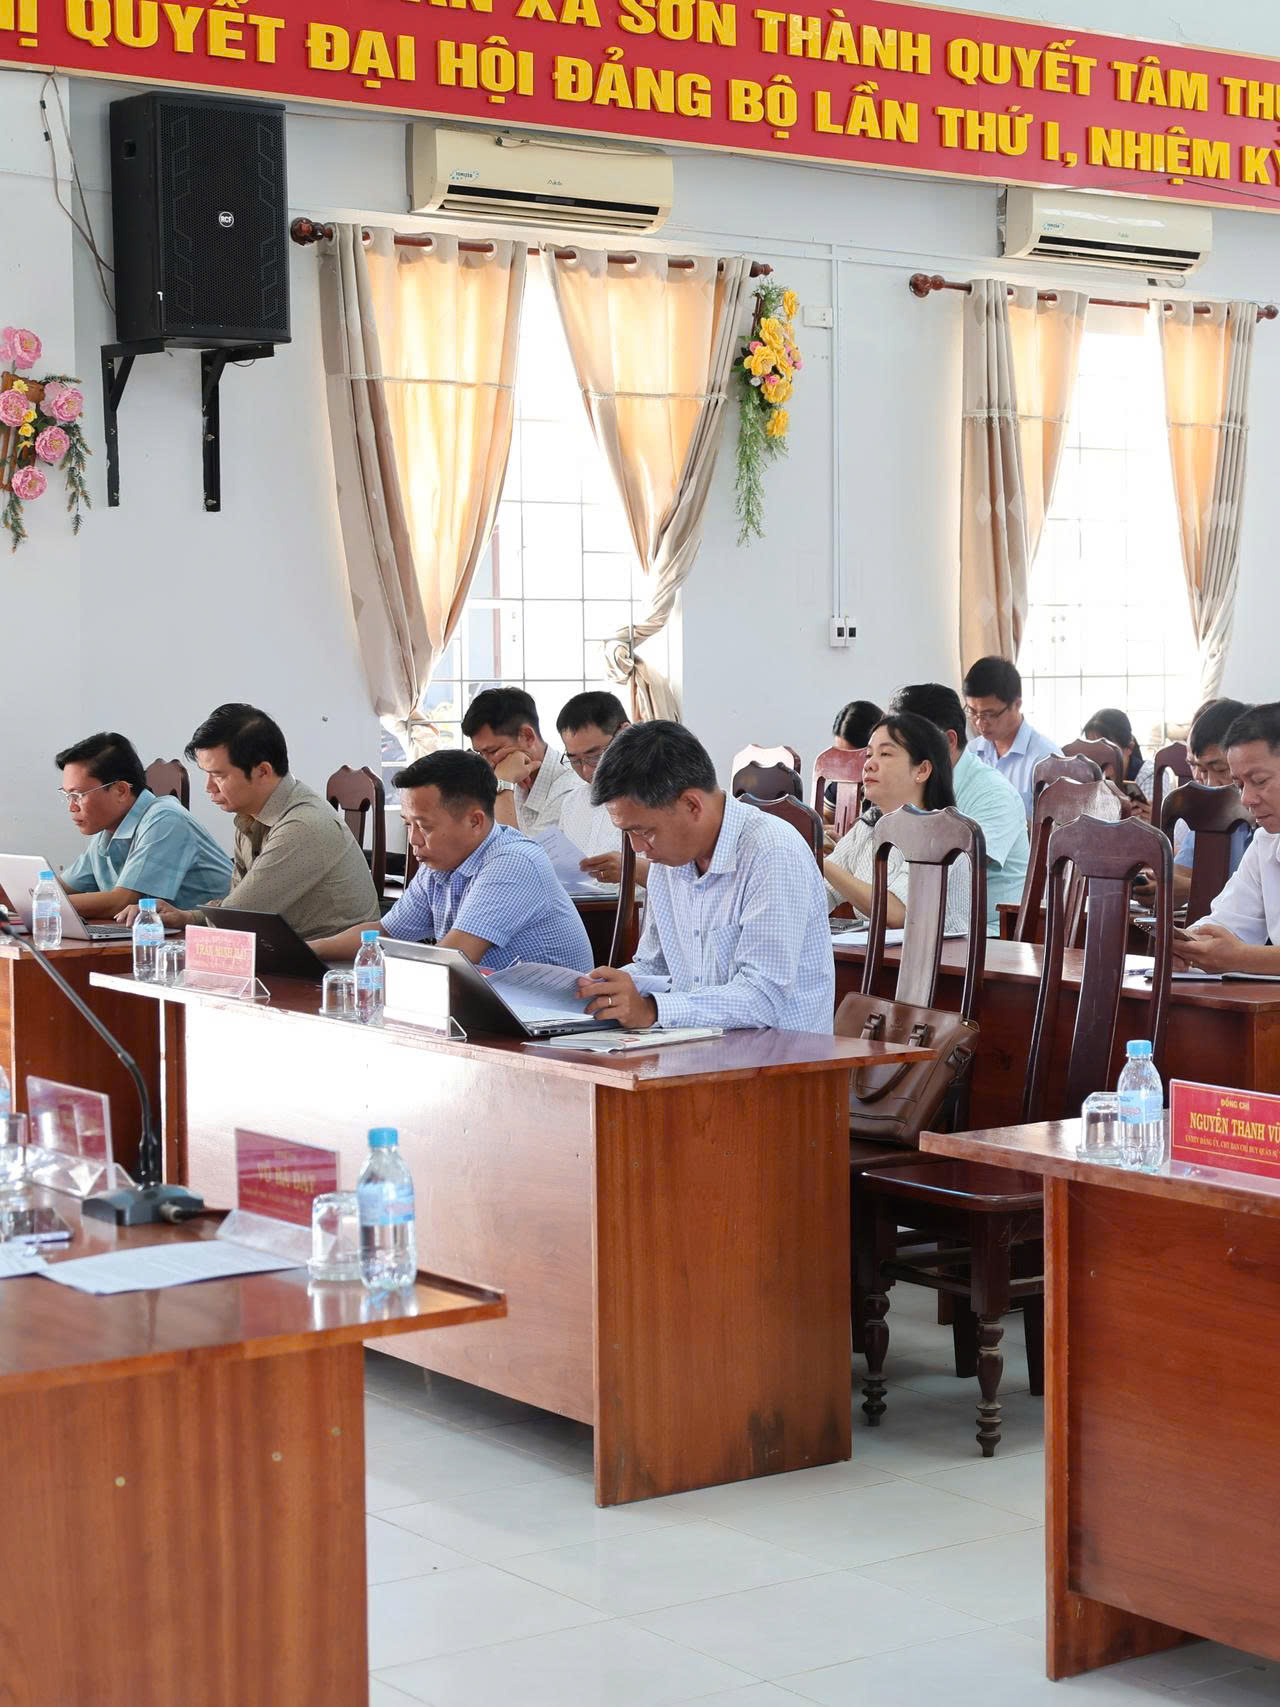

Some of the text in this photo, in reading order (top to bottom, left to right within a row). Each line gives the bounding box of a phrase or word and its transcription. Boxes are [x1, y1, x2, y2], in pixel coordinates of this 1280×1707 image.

[65, 0, 285, 64] QUYẾT
[304, 22, 416, 89] ĐẠI
[436, 35, 535, 104] HỘI
[551, 46, 712, 119] ĐẢNG
[728, 74, 798, 140] BỘ
[813, 80, 919, 144] LẦN
[934, 105, 1034, 157] THỨ
[1042, 121, 1079, 168] I,
[1088, 126, 1230, 186] NHIỆM
[618, 0, 737, 47] SƠN
[754, 8, 931, 75] THÀNH
[948, 38, 1097, 96] QUYẾT
[1109, 55, 1209, 112] TÂM
[1190, 1108, 1229, 1135] NGUYỄN
[1231, 1119, 1265, 1141] THANH
